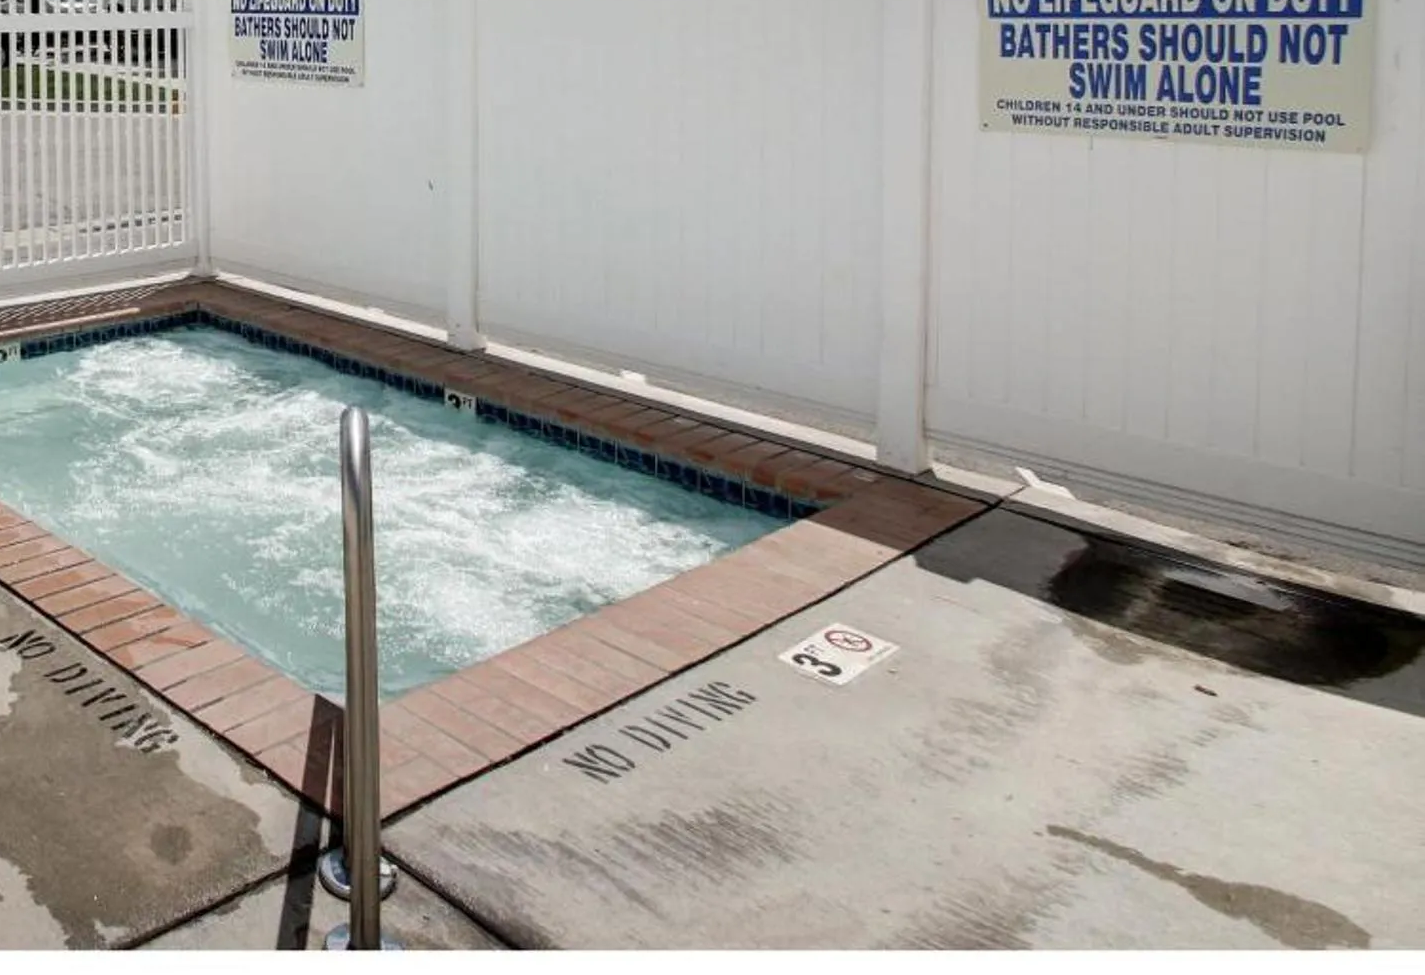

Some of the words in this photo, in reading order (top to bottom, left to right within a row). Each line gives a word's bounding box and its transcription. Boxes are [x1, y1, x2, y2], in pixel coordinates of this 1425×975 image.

[235, 17, 282, 38] BATHERS
[284, 17, 329, 39] SHOULD
[333, 19, 356, 40] NOT
[260, 39, 289, 61] SWIM
[292, 40, 328, 63] ALONE
[1000, 23, 1130, 61] BATHERS
[1139, 24, 1267, 64] SHOULD
[1279, 24, 1349, 66] NOT
[1069, 62, 1147, 102] SWIM
[1156, 64, 1262, 105] ALONE
[996, 99, 1061, 113] CHILDREN
[1065, 103, 1082, 114] 14
[1086, 104, 1113, 116] AND
[1117, 105, 1166, 118] UNDER
[1170, 106, 1229, 122] SHOULD
[1233, 109, 1265, 123] NOT
[1268, 111, 1299, 125] USE
[1302, 112, 1347, 126] POOL
[1012, 113, 1071, 128] WITHOUT
[1074, 117, 1170, 134] RESPONSIBLE
[1174, 122, 1221, 137] ADULT
[1224, 125, 1327, 143] SUPERVISION
[791, 653, 842, 677] 3
[43, 662, 180, 755] DIVING
[562, 743, 636, 785] NO
[617, 680, 757, 753] DIVING
